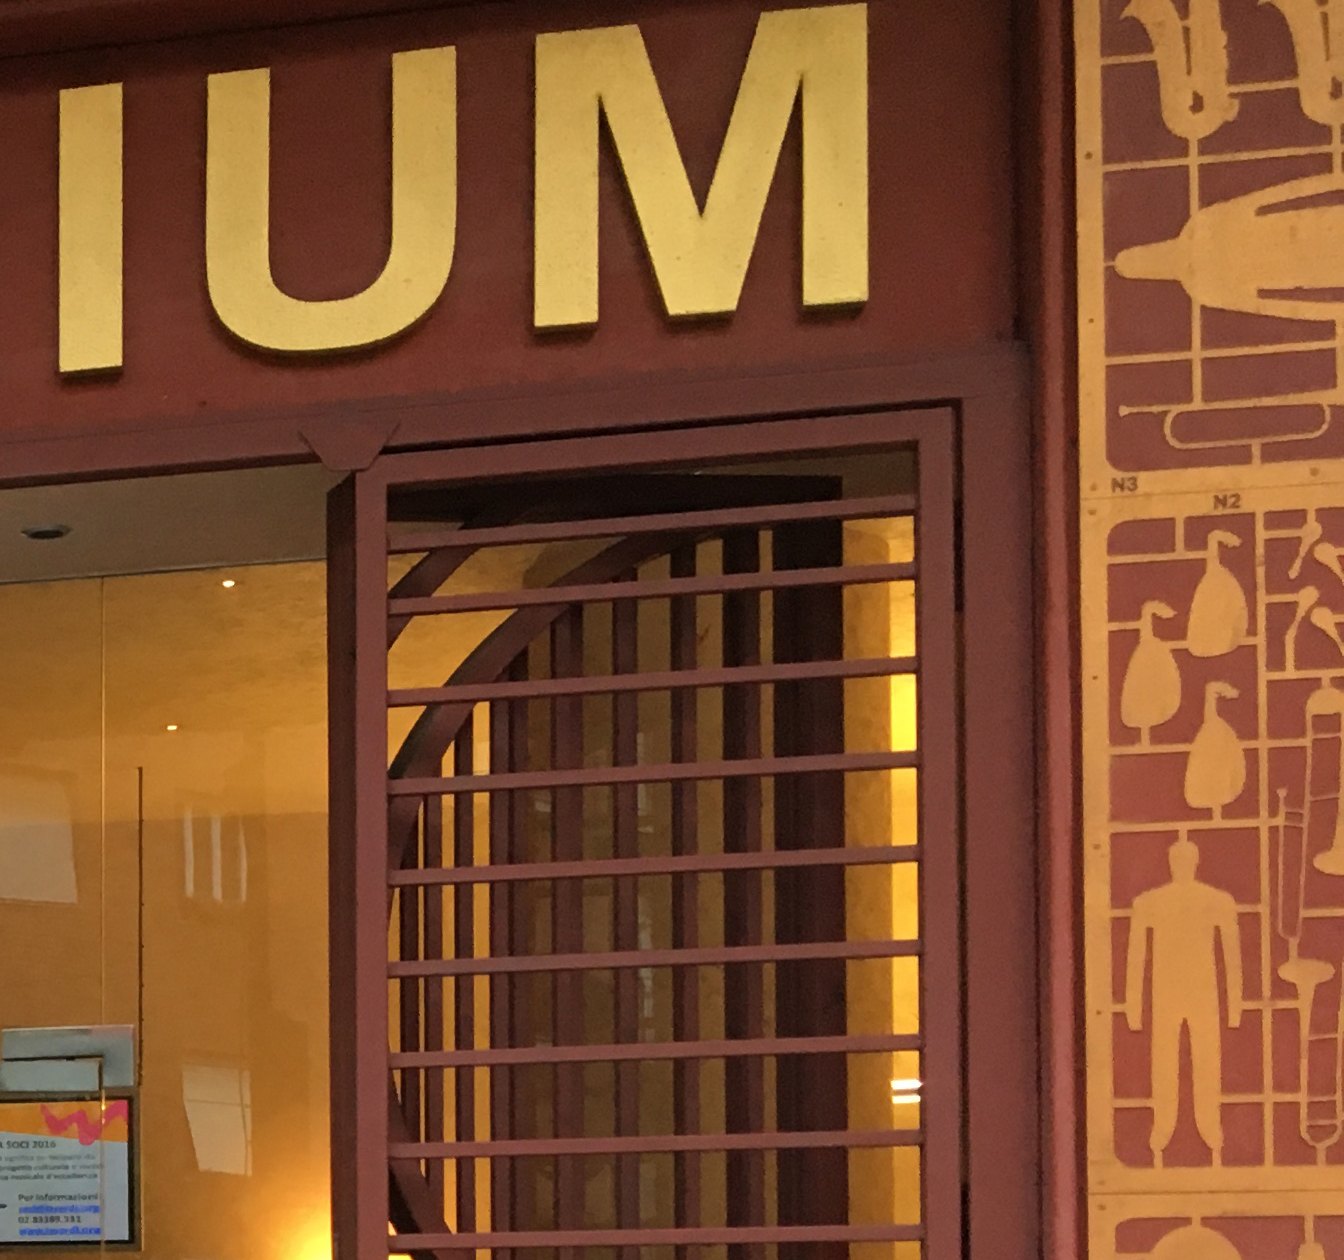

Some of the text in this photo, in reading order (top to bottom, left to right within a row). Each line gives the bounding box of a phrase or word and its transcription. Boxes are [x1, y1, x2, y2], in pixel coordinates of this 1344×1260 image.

[1111, 475, 1138, 493] N3
[1213, 492, 1241, 510] N2
[6, 1140, 30, 1150] SOCI
[32, 1139, 56, 1149] 2016
